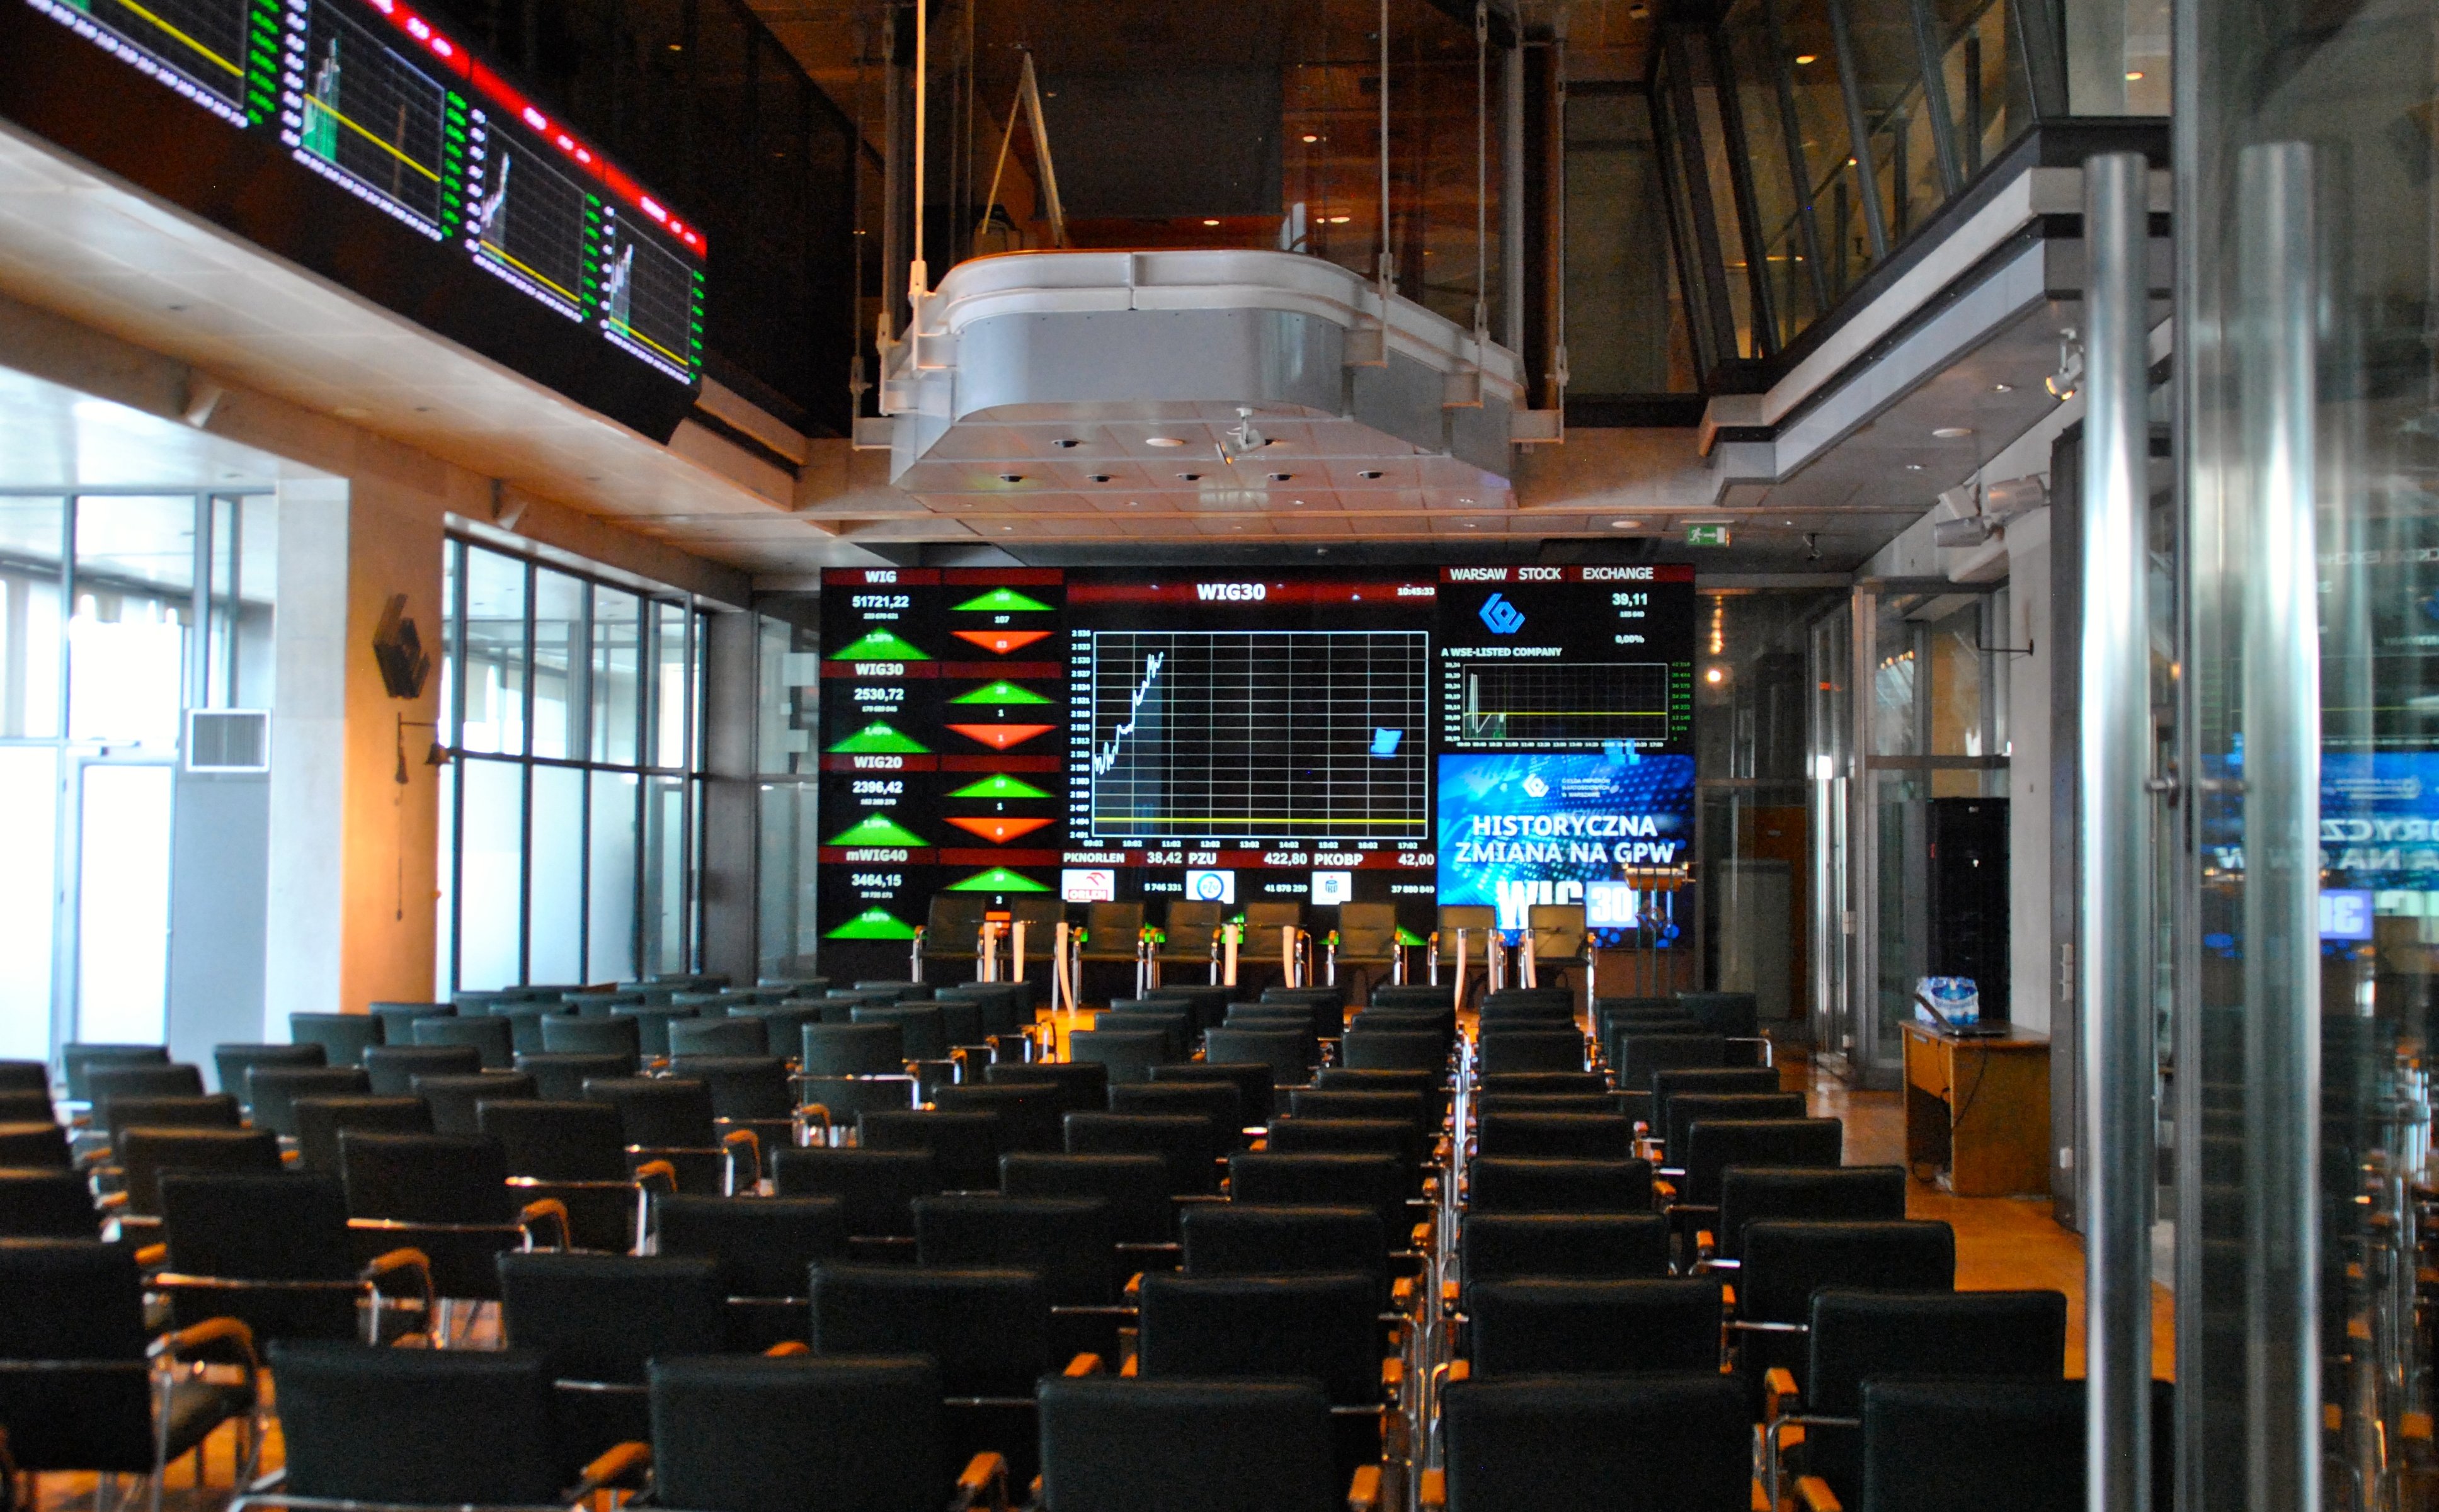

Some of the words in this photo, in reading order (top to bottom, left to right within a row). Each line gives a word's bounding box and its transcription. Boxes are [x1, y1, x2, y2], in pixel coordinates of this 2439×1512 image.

[865, 571, 896, 583] WIG
[1450, 568, 1507, 580] WARSAW
[1519, 567, 1561, 580] STOCK
[1583, 567, 1654, 579] EXCHANGE
[1197, 584, 1265, 600] WIG30
[852, 596, 908, 608] 51721,22
[1613, 593, 1647, 606] 39,11
[1616, 635, 1645, 644] 0,00%
[1441, 648, 1449, 656] A
[1451, 647, 1511, 656] WSE-LISTED
[1513, 647, 1562, 656] COMPANY
[855, 663, 903, 676] WIG30
[854, 688, 903, 702] 2530,72
[854, 756, 902, 768] WIG20
[853, 781, 902, 795] 2396,42
[1473, 816, 1658, 836] HISTORYCZNA
[846, 849, 907, 861] mWIG40
[1063, 853, 1124, 863] PKNORLEN
[1147, 851, 1182, 865] 38,42
[1456, 842, 1562, 862] ZMIANA
[1570, 842, 1608, 863] NA
[1614, 843, 1676, 863] GPW
[1189, 853, 1216, 865] PZU
[1264, 853, 1307, 866] 422,80
[1314, 853, 1363, 865] PKOBP
[1398, 853, 1434, 867] 42,00
[852, 874, 901, 888] 3464,15
[1069, 890, 1107, 901] ORLEN
[1591, 887, 1632, 922] 30
